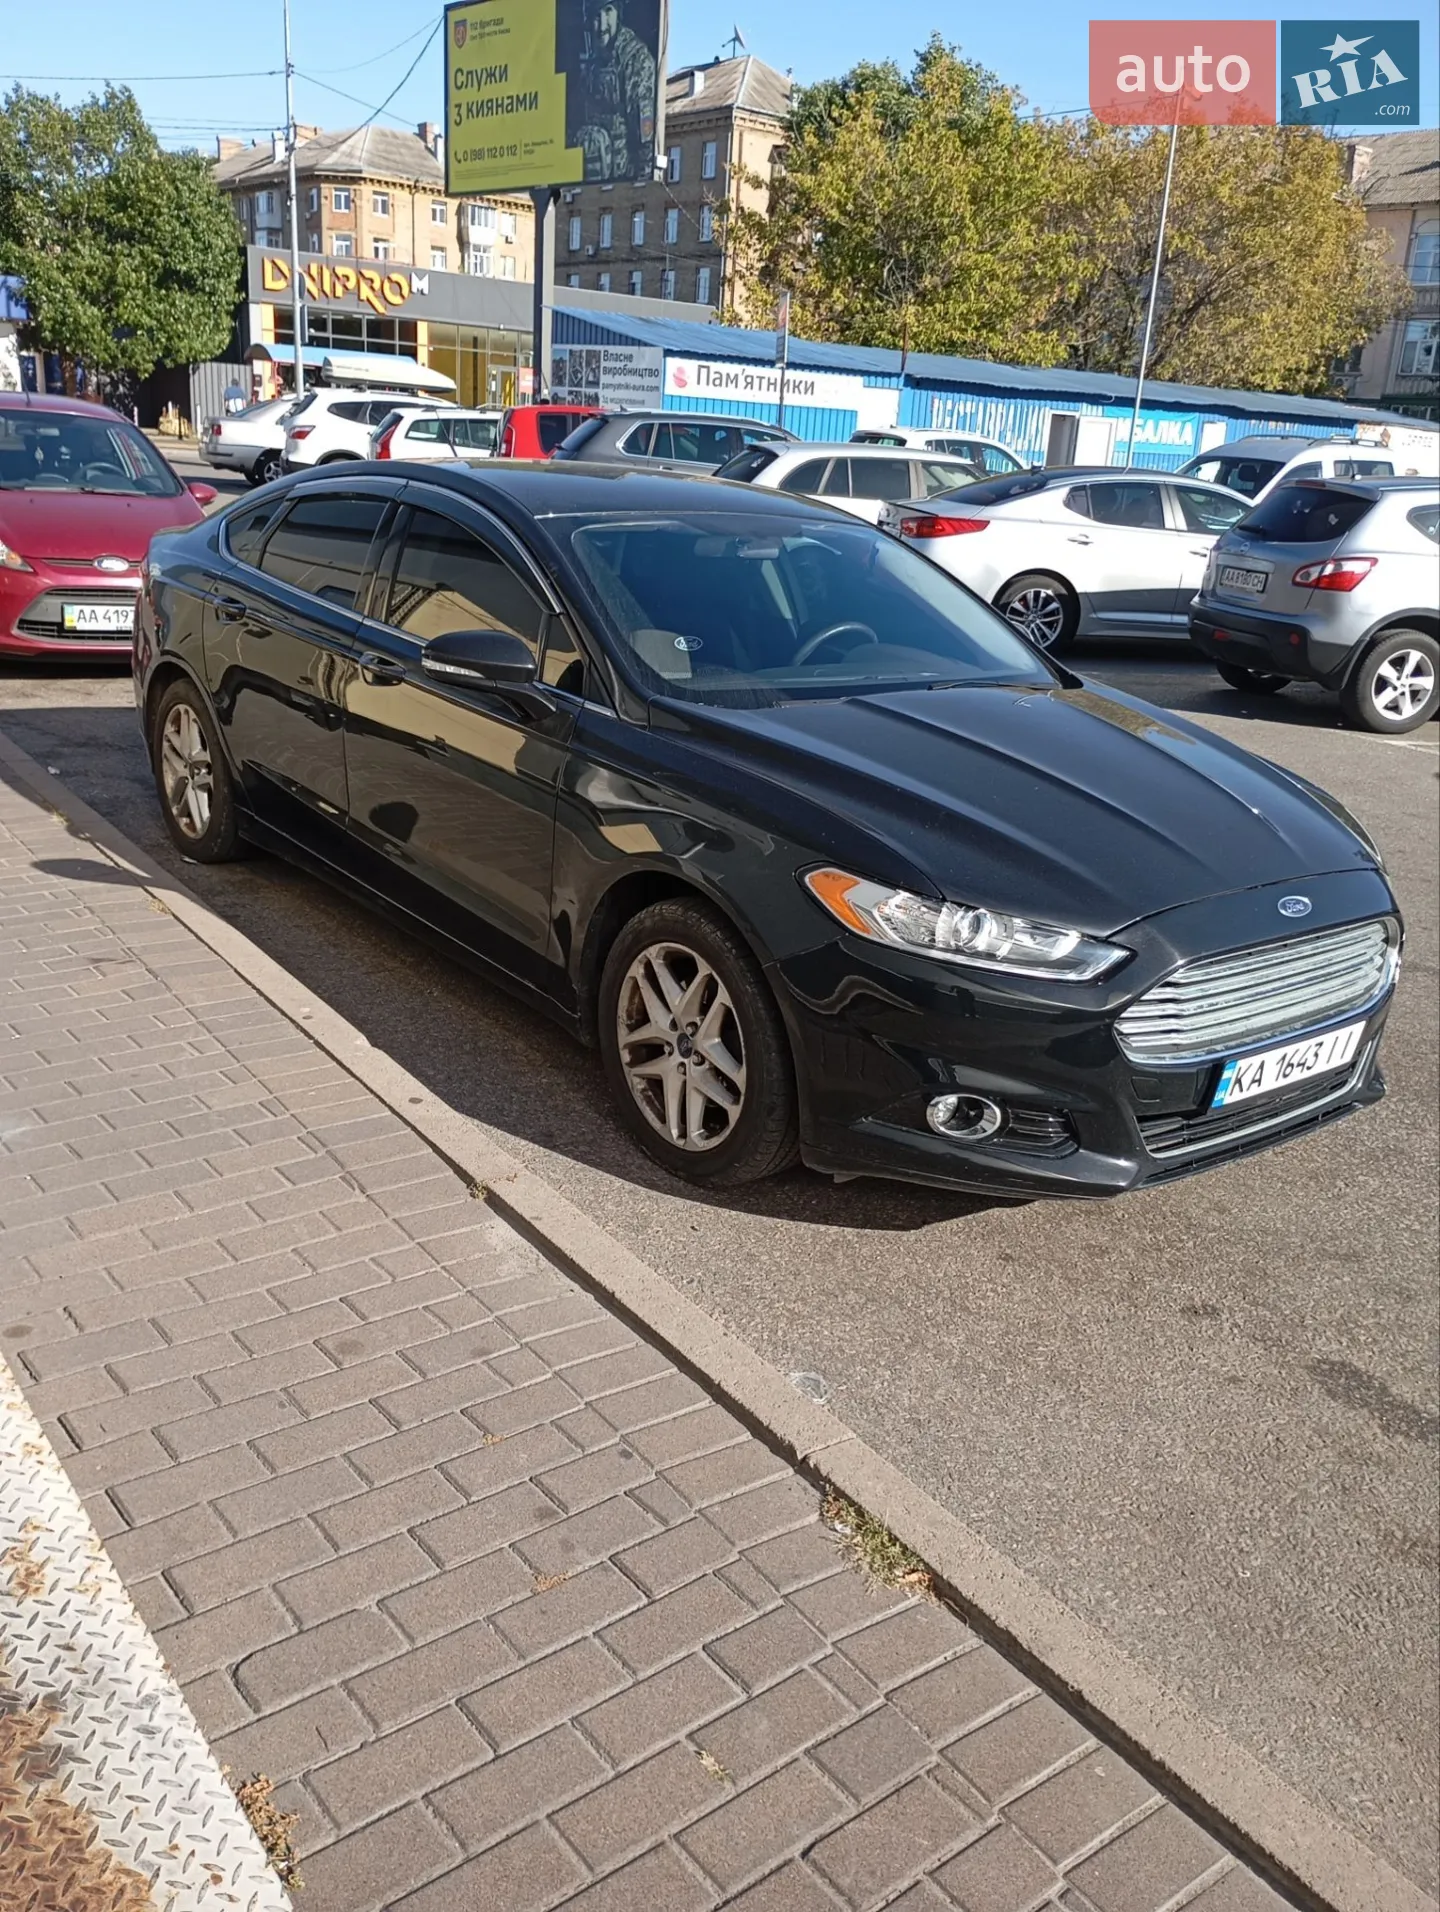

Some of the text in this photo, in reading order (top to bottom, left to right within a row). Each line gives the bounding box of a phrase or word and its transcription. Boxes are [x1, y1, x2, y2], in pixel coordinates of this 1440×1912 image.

[454, 63, 508, 93] Служи
[466, 90, 539, 120] киянами
[462, 150, 469, 162] 0
[470, 148, 485, 162] (98)
[487, 147, 498, 159] 112
[499, 146, 505, 158] 0
[506, 144, 518, 157] 112
[602, 350, 634, 363] Власне
[602, 364, 660, 380] виробництво
[696, 364, 816, 396] Пам'ятники
[1115, 416, 1193, 447] ИБАЛКА
[77, 609, 99, 624] AA
[1229, 1059, 1265, 1097] KA
[1274, 1040, 1324, 1084] 1643
